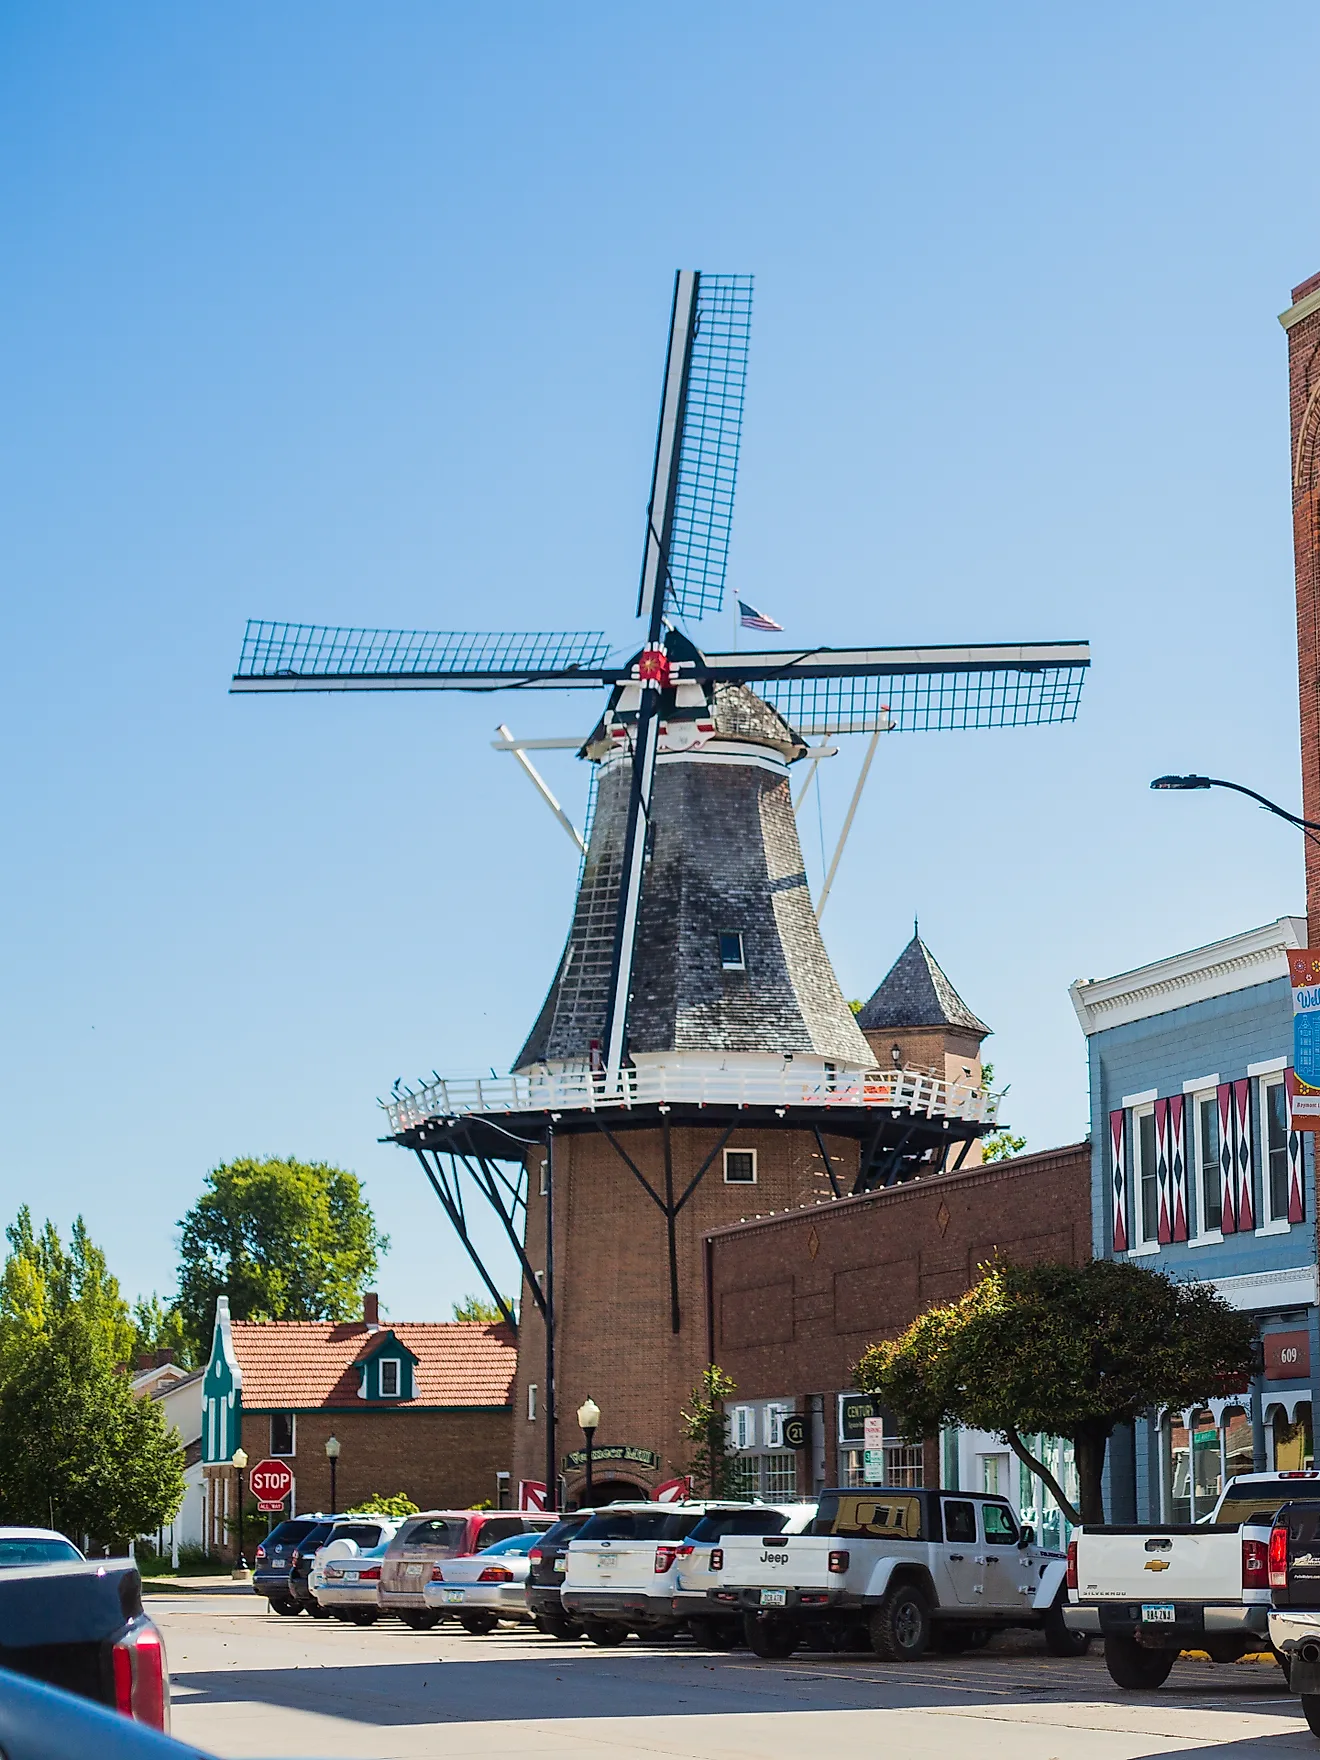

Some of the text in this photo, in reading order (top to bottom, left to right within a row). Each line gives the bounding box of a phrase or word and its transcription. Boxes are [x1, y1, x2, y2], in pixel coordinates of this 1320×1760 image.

[1281, 1347, 1297, 1363] 609
[253, 1472, 290, 1489] STOP
[760, 1550, 789, 1566] Jeep
